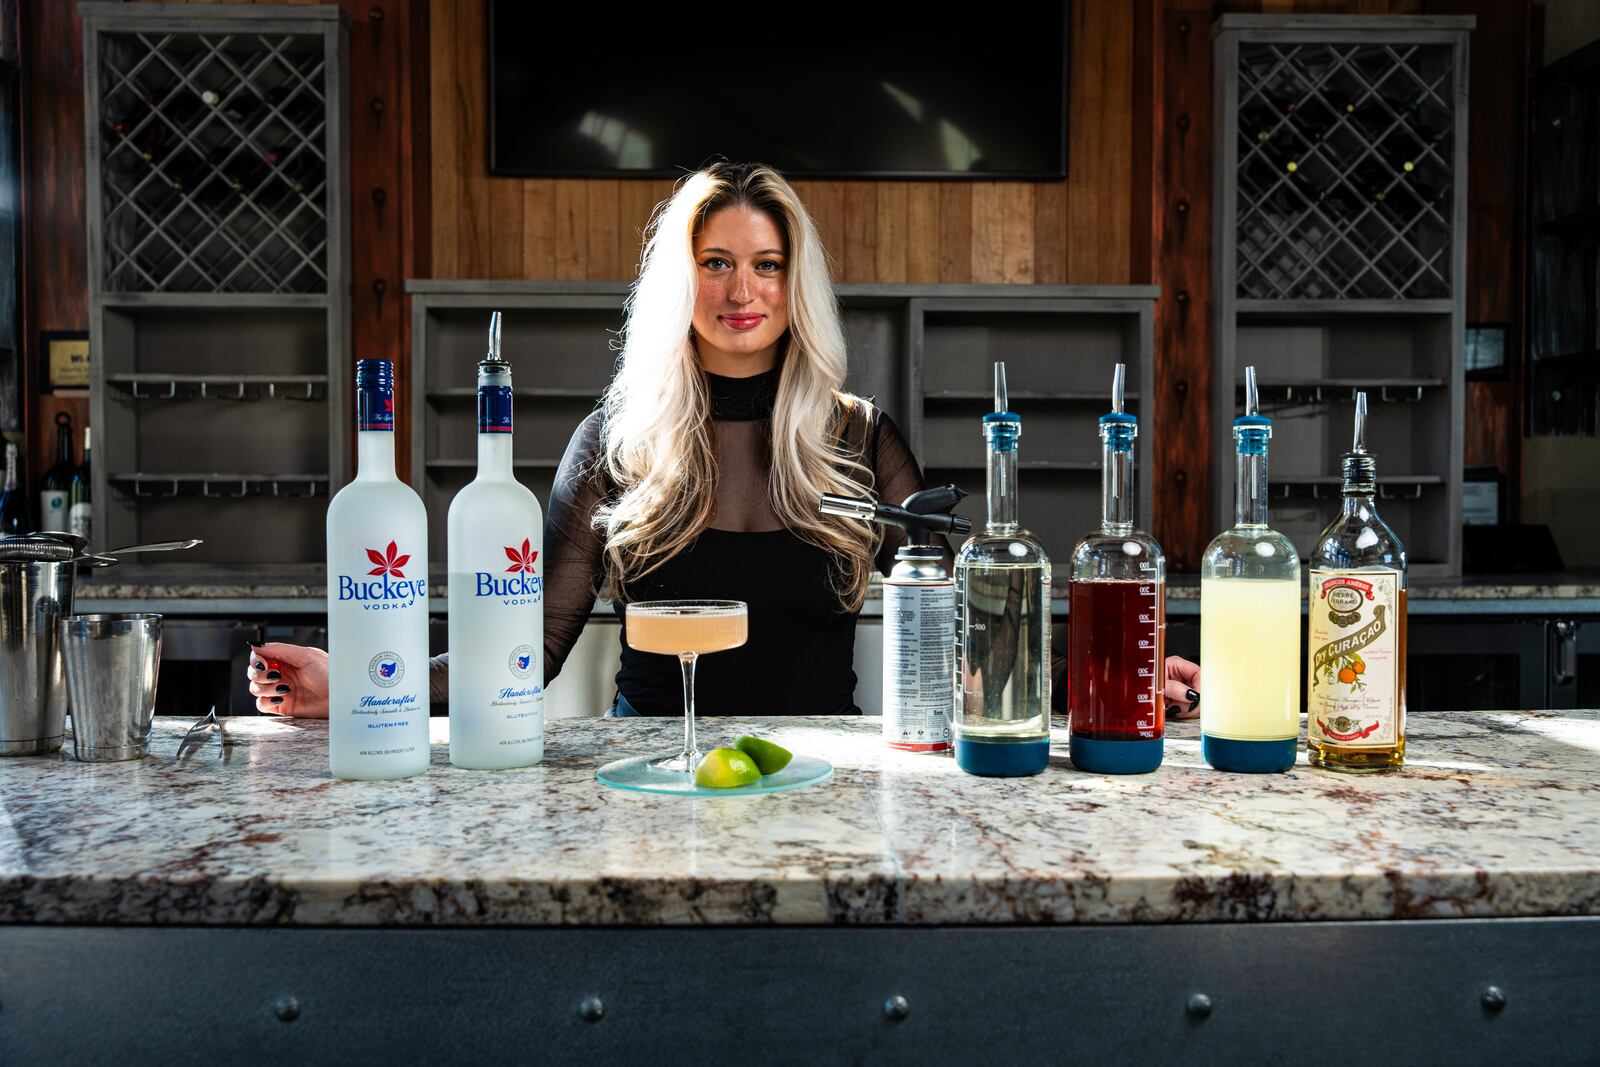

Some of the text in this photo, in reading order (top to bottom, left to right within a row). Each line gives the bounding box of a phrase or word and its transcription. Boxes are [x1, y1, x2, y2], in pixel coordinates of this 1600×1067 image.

[338, 572, 426, 606] Buckeye
[1328, 620, 1382, 657] CURAÇAO
[360, 694, 417, 708] Handcrafted
